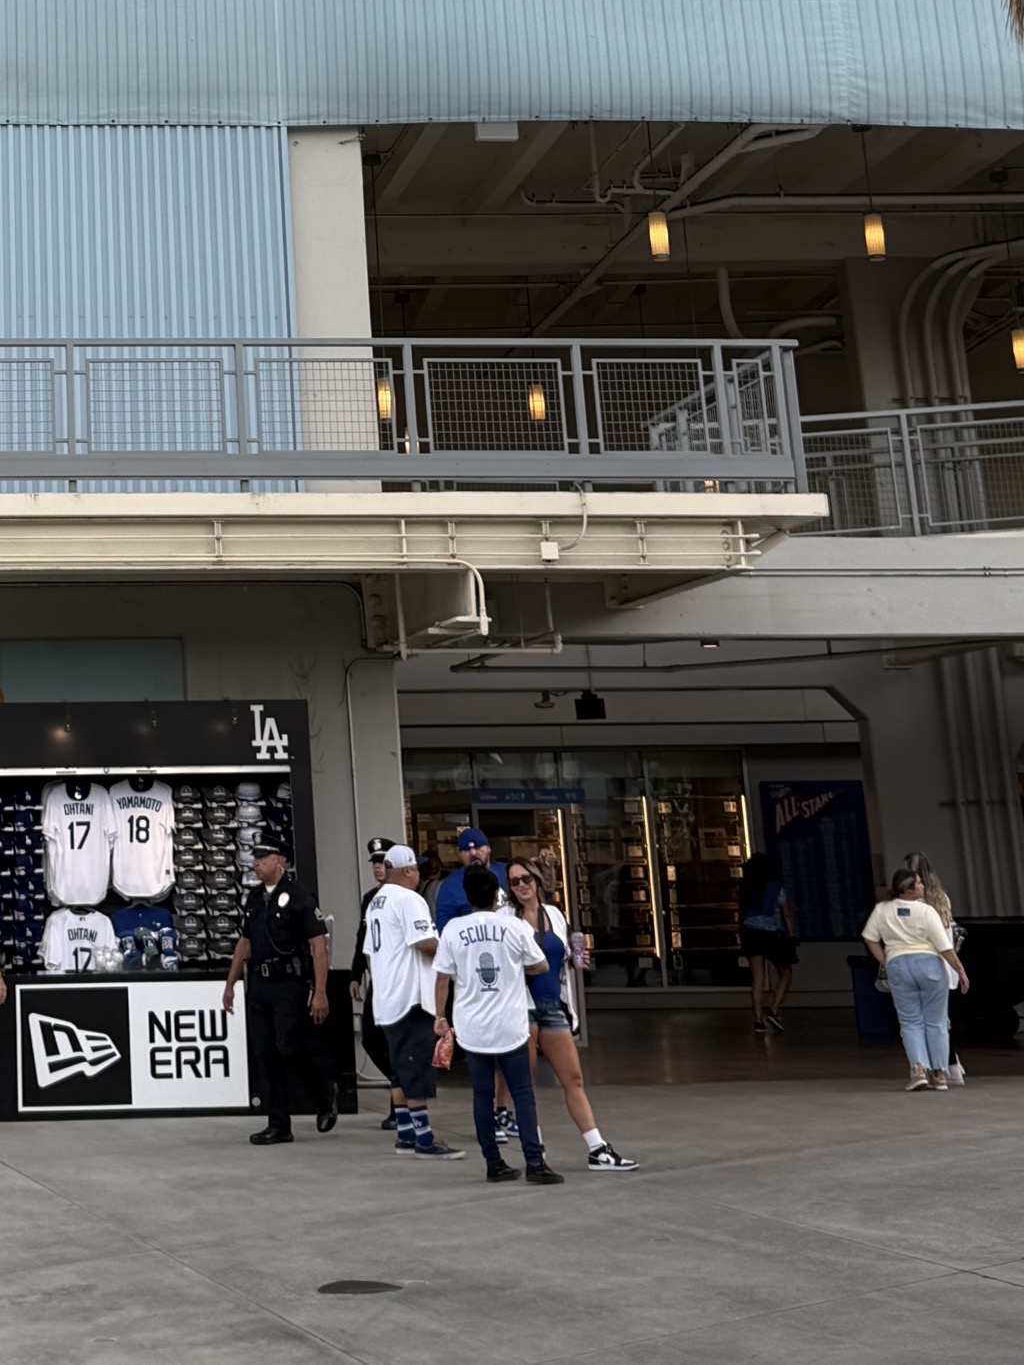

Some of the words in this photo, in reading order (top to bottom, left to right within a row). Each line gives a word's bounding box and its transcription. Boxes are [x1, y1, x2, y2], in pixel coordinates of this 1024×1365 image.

[250, 704, 289, 760] LA
[63, 803, 95, 815] OHTANI
[117, 796, 163, 812] YAMAMOTO
[68, 821, 91, 849] 17
[128, 815, 150, 843] 18
[68, 928, 98, 942] OHTANI
[459, 924, 506, 947] SCULLY
[72, 946, 92, 972] 17
[148, 1008, 228, 1044] NEW
[149, 1044, 230, 1079] ERA
